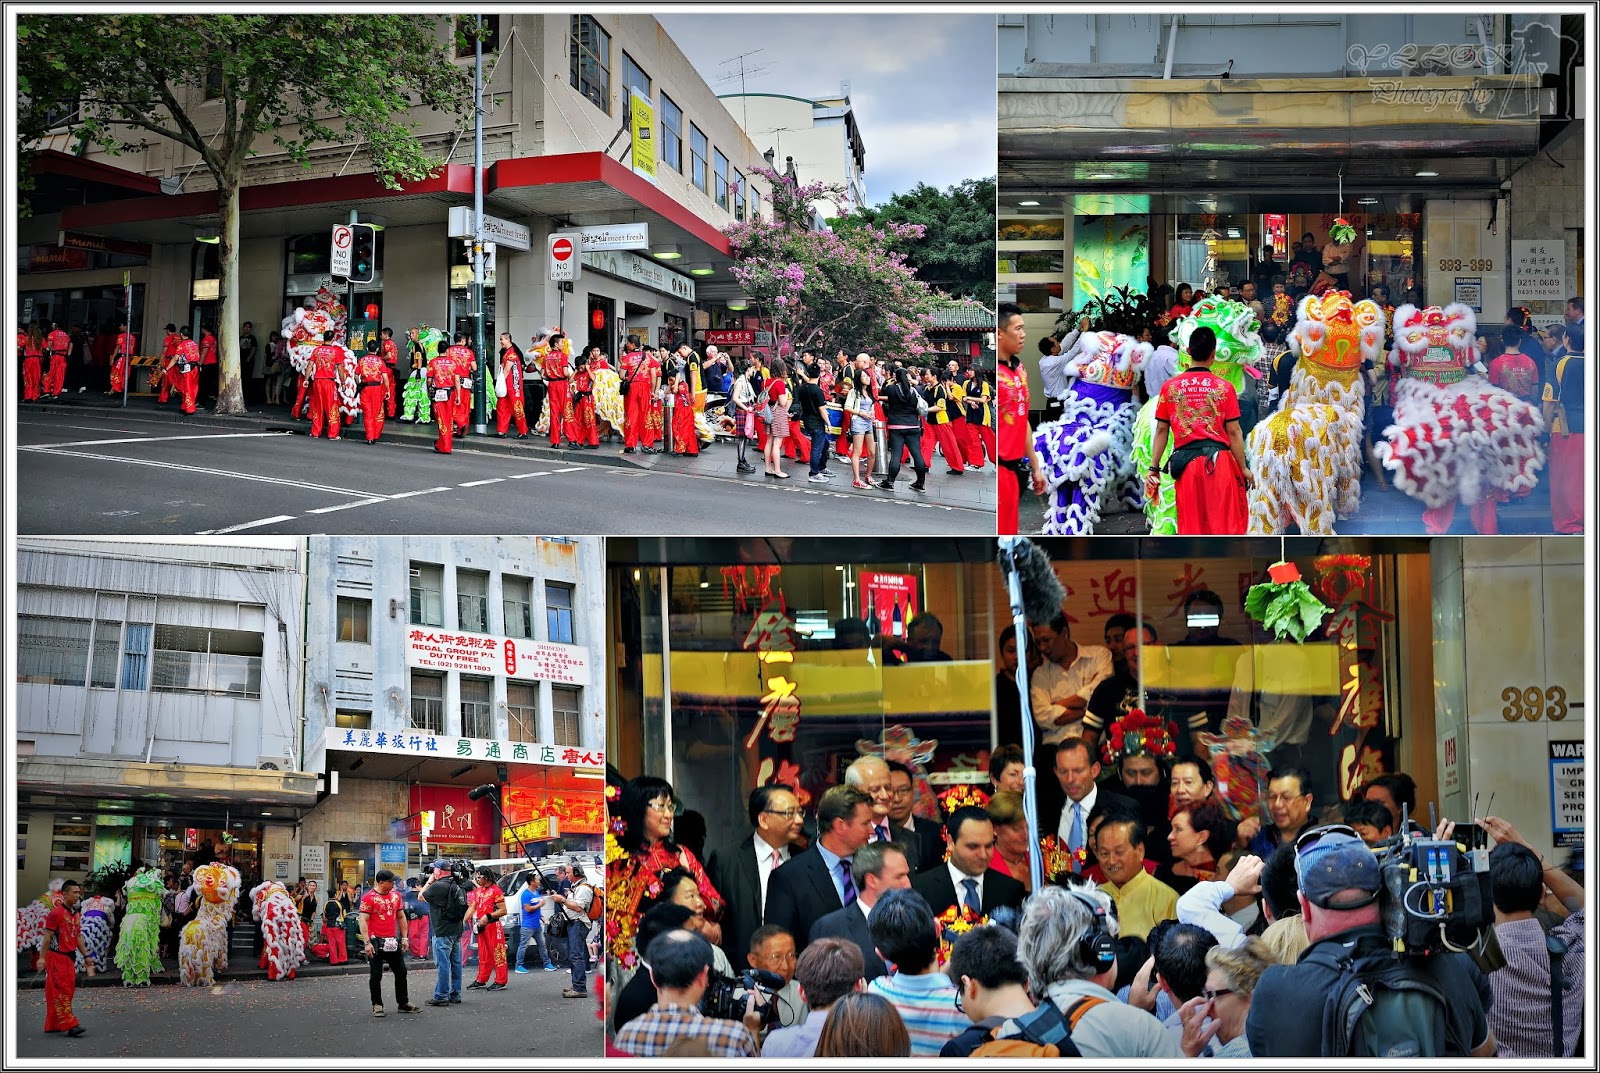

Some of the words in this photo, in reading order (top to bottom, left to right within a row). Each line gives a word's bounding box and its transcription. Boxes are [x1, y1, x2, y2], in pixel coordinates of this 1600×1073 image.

[514, 226, 527, 240] fresh
[626, 233, 644, 241] fresh
[68, 239, 106, 249] mamak
[32, 249, 71, 263] mamak
[336, 250, 347, 259] NO
[1440, 259, 1493, 272] 393-399
[412, 643, 443, 652] REGAL
[446, 647, 479, 656] GROUP
[430, 652, 454, 660] DUTY
[343, 729, 438, 752] 美麗華旅行社
[457, 739, 555, 763] 易通商店
[1445, 737, 1457, 768] OPEN
